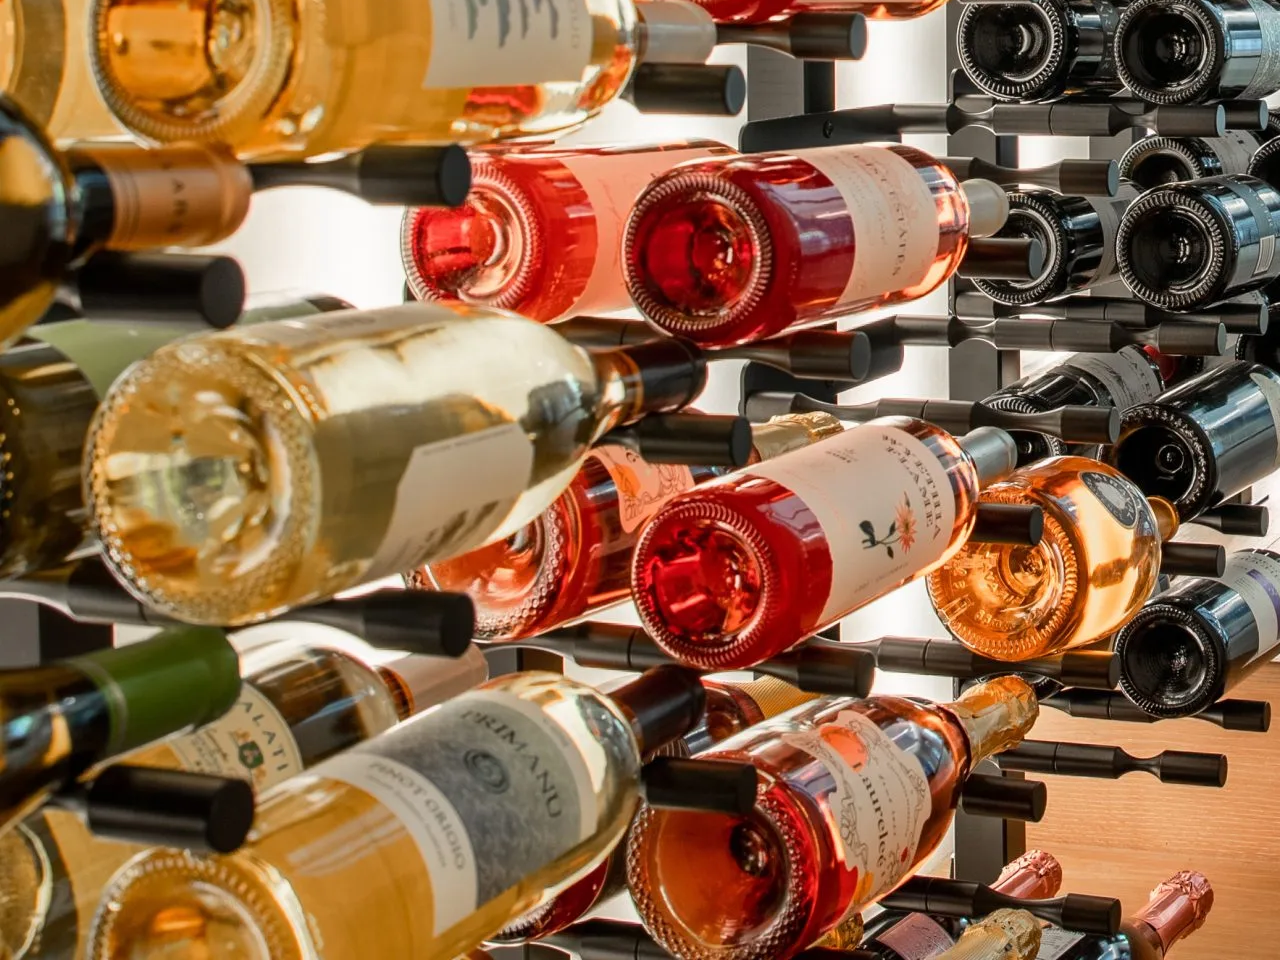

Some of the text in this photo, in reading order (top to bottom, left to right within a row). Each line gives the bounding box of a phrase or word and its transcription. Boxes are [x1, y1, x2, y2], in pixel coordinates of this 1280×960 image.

[367, 761, 429, 797] PINOT
[424, 794, 468, 871] GRIGIO
[459, 708, 563, 819] PRIMANU
